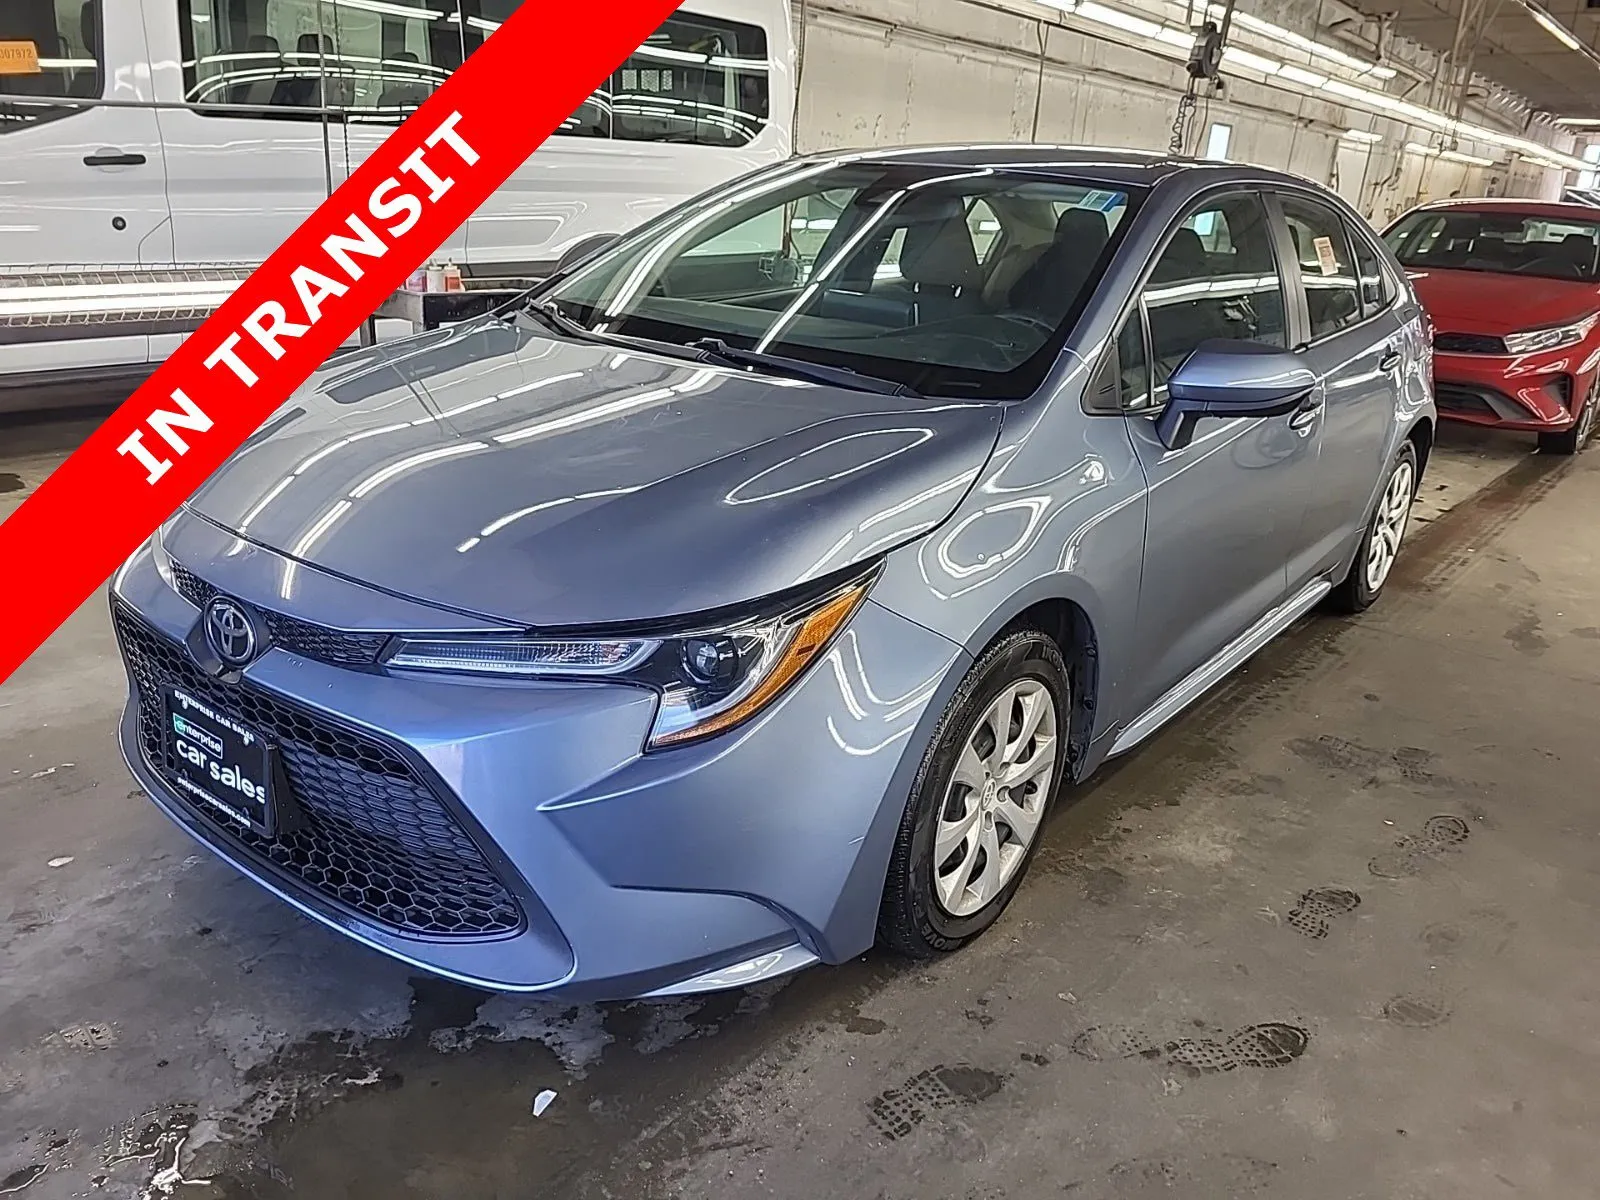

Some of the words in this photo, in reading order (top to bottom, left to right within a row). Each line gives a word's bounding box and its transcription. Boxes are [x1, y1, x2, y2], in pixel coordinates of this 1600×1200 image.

[175, 720, 222, 752] enterprise
[215, 714, 232, 729] CAR
[176, 739, 208, 769] car
[210, 764, 266, 805] sales
